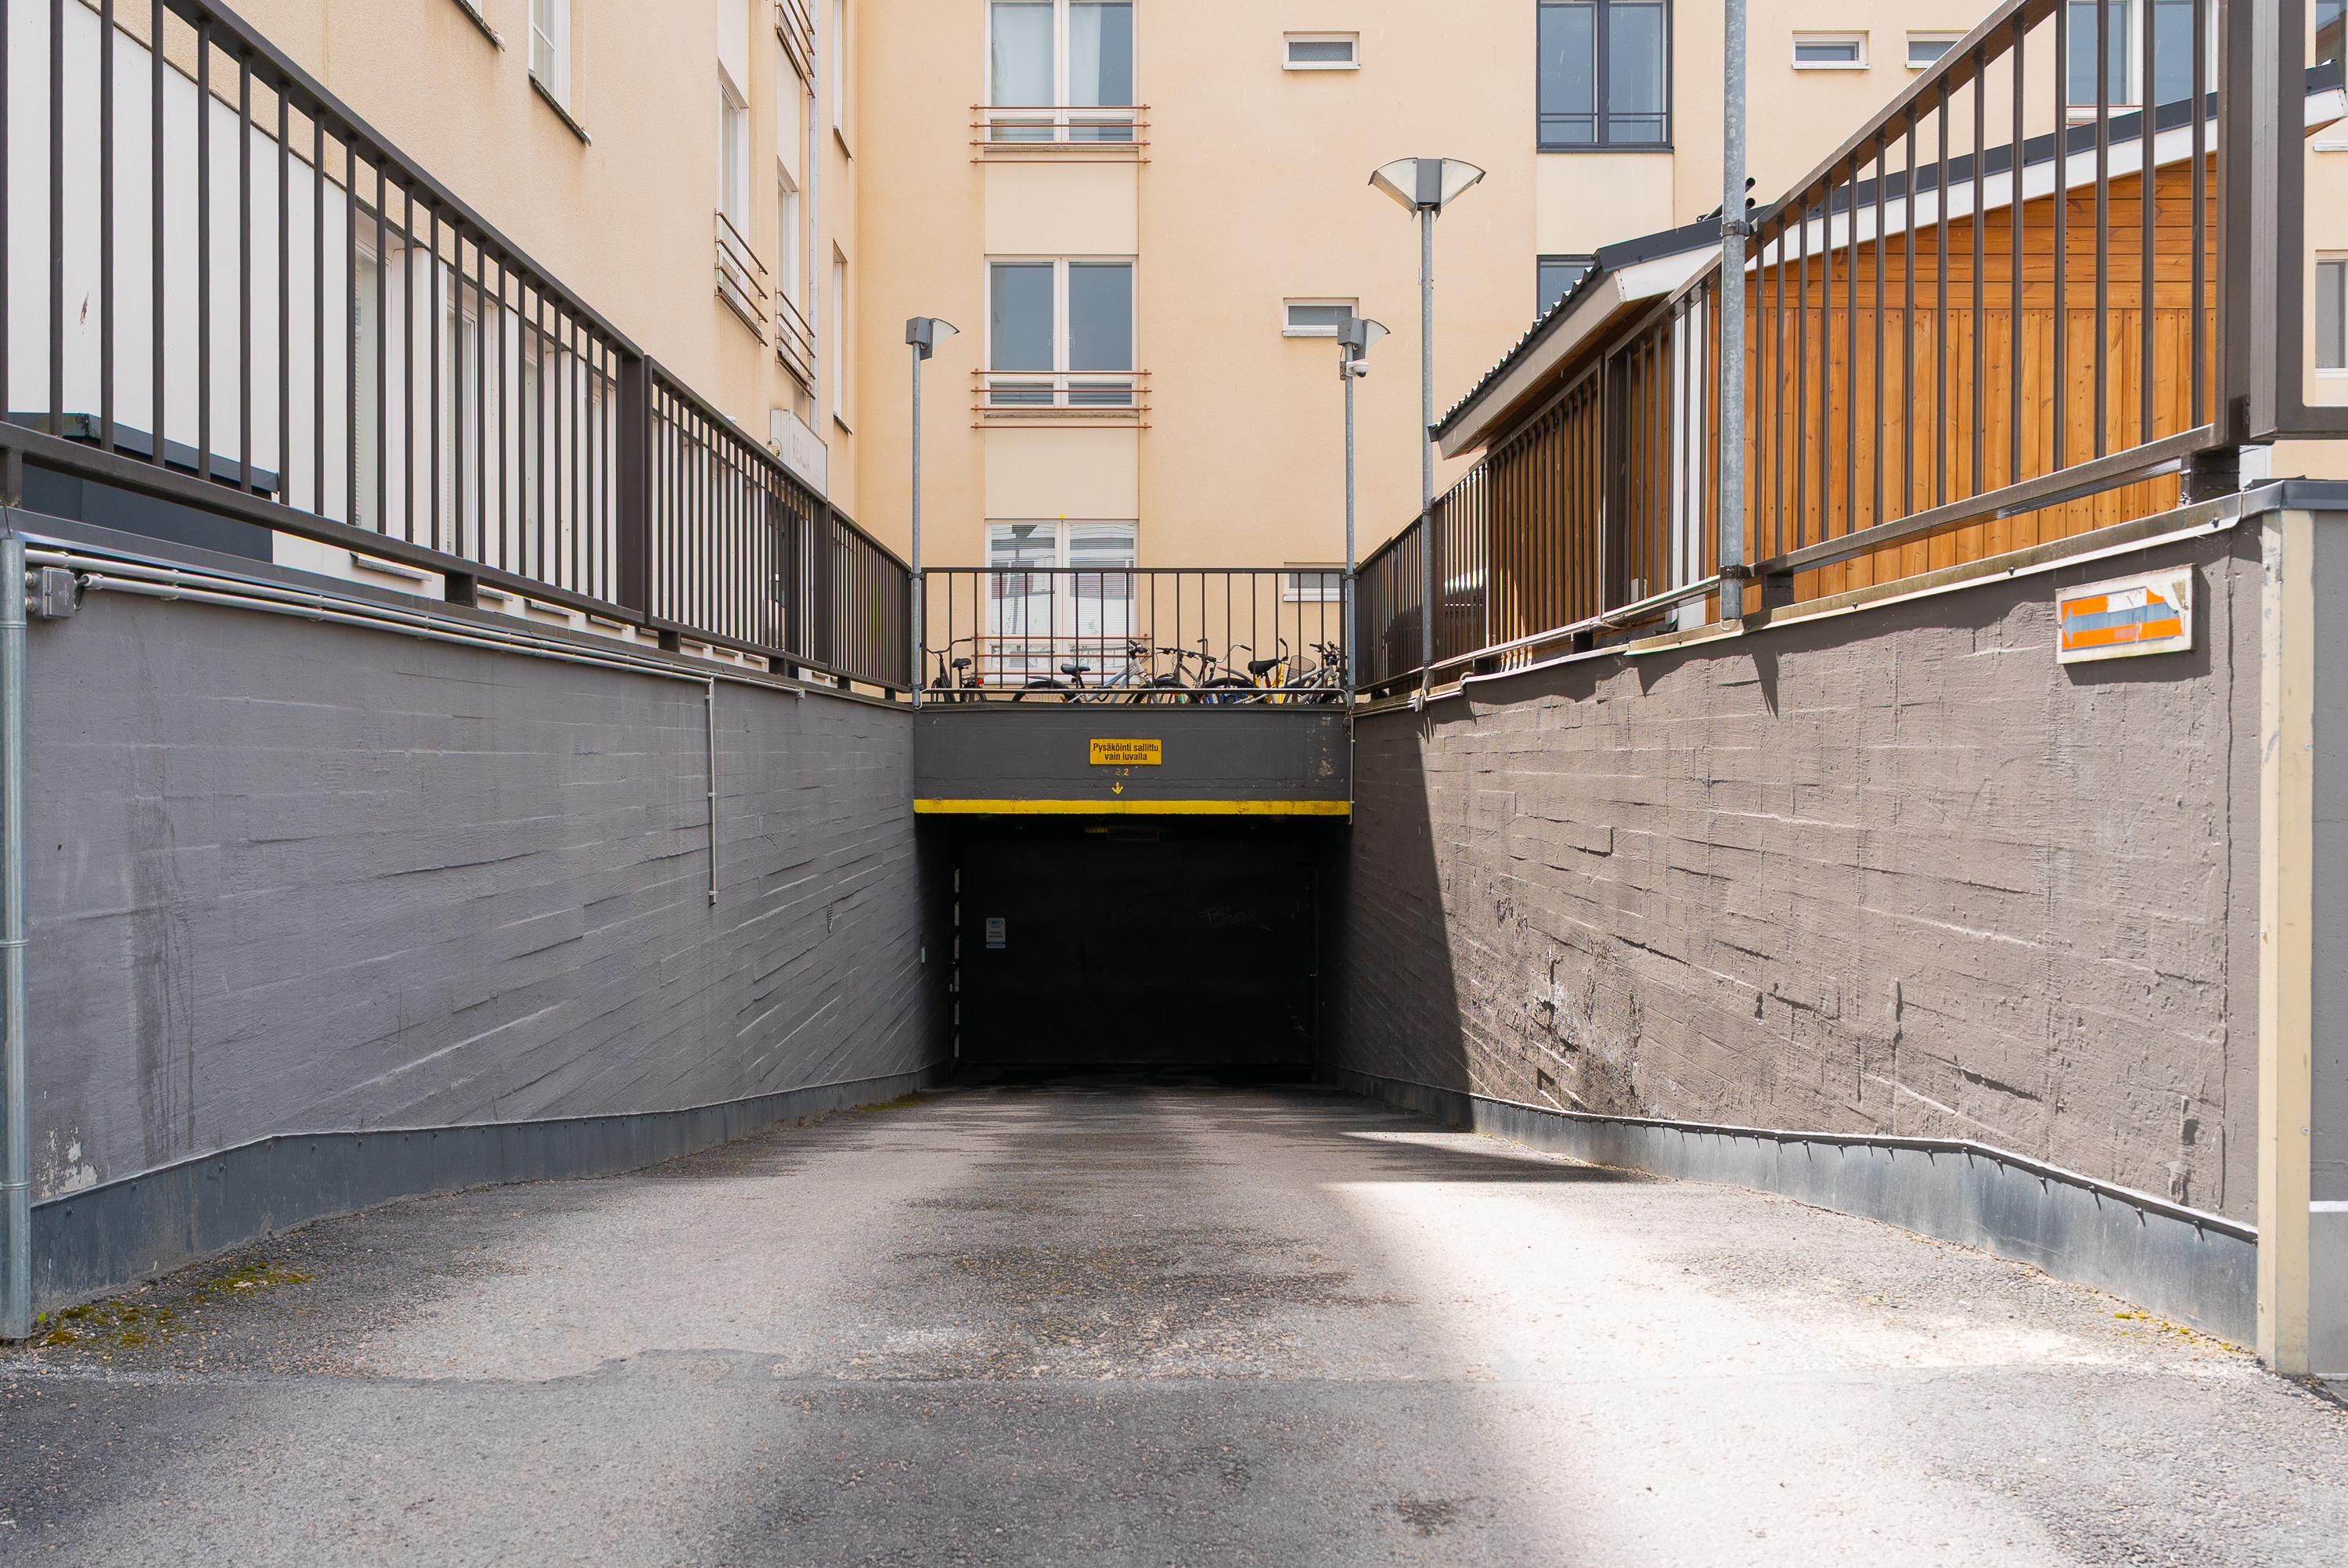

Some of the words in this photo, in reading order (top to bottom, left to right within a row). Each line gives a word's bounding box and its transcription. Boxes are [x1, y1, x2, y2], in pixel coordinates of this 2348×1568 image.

[1093, 743, 1132, 753] Pysäköinti
[1133, 743, 1158, 752] sallittu
[1104, 752, 1121, 761] vain
[1122, 752, 1147, 761] luvalla
